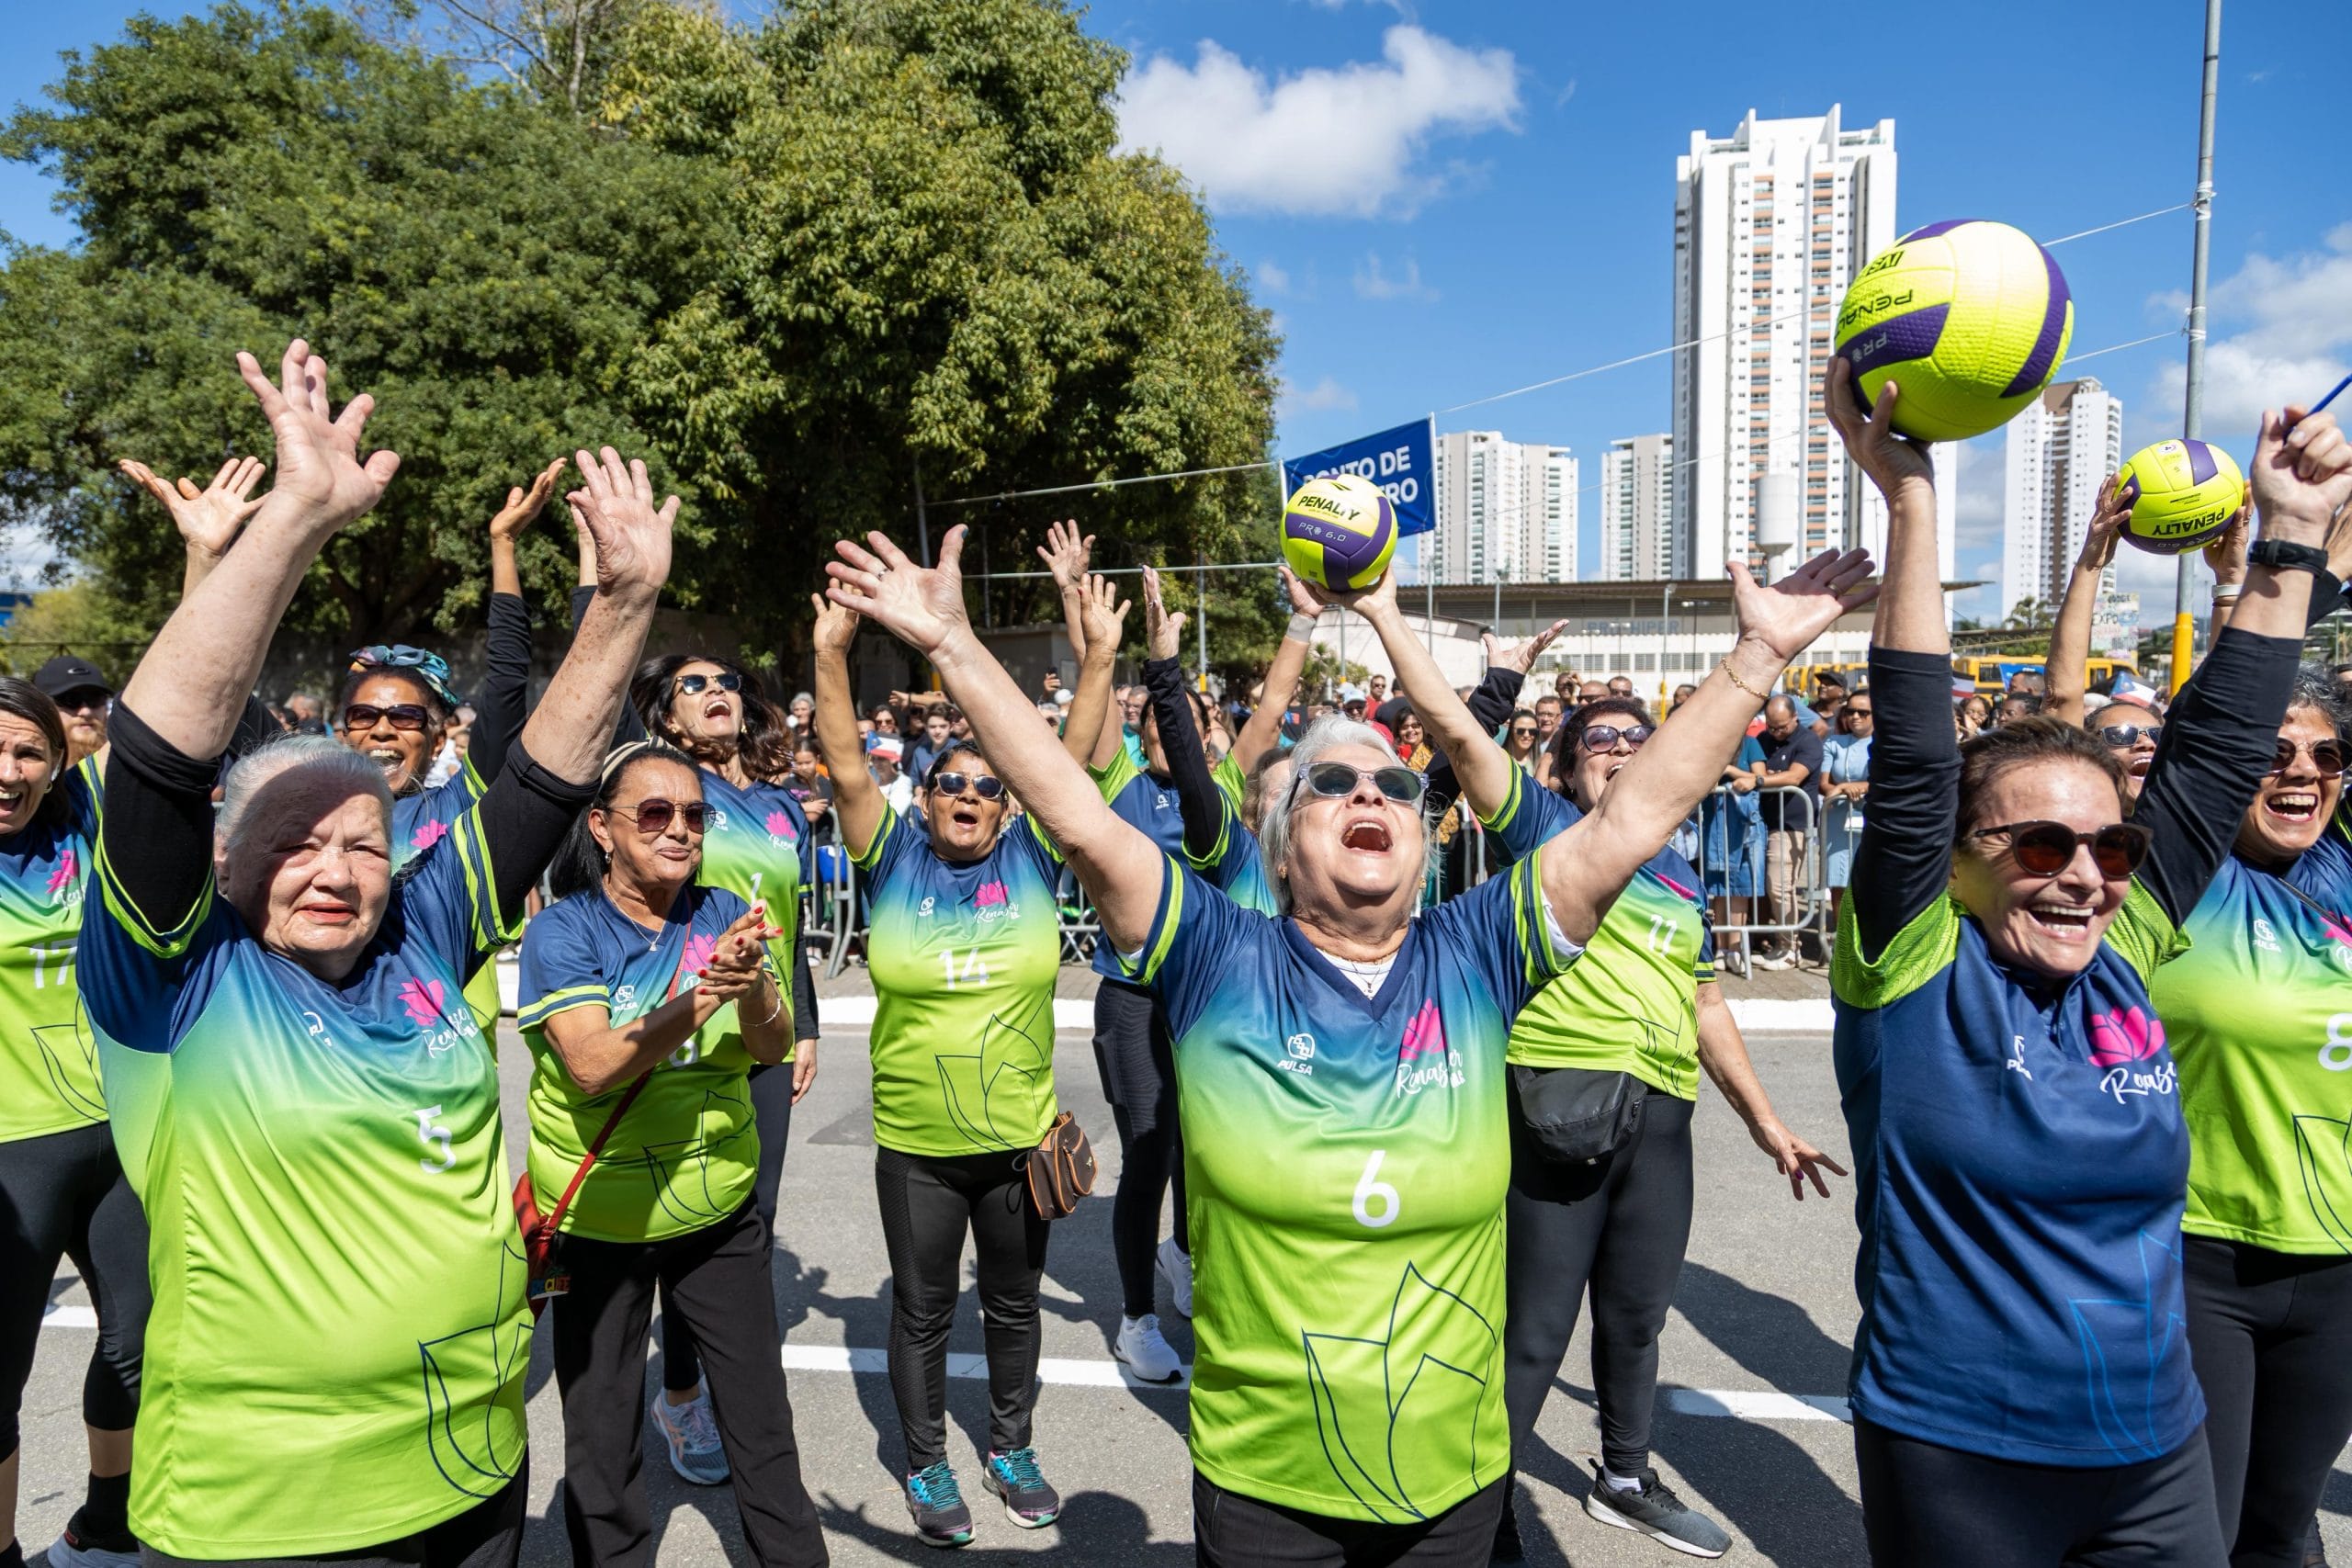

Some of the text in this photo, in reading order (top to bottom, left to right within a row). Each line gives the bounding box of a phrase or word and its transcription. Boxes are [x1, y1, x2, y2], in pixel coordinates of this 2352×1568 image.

[1835, 288, 1914, 340] PENAL
[1380, 446, 1412, 477] DE
[1297, 496, 1361, 522] PENALY
[2152, 507, 2225, 536] PENALTY
[1325, 531, 1347, 542] 6.0
[29, 937, 78, 989] 17
[938, 947, 990, 990] 14
[2317, 1012, 2352, 1071] 8
[1277, 1059, 1313, 1077] PULSA
[414, 1104, 457, 1174] 5
[1352, 1149, 1400, 1228] 6
